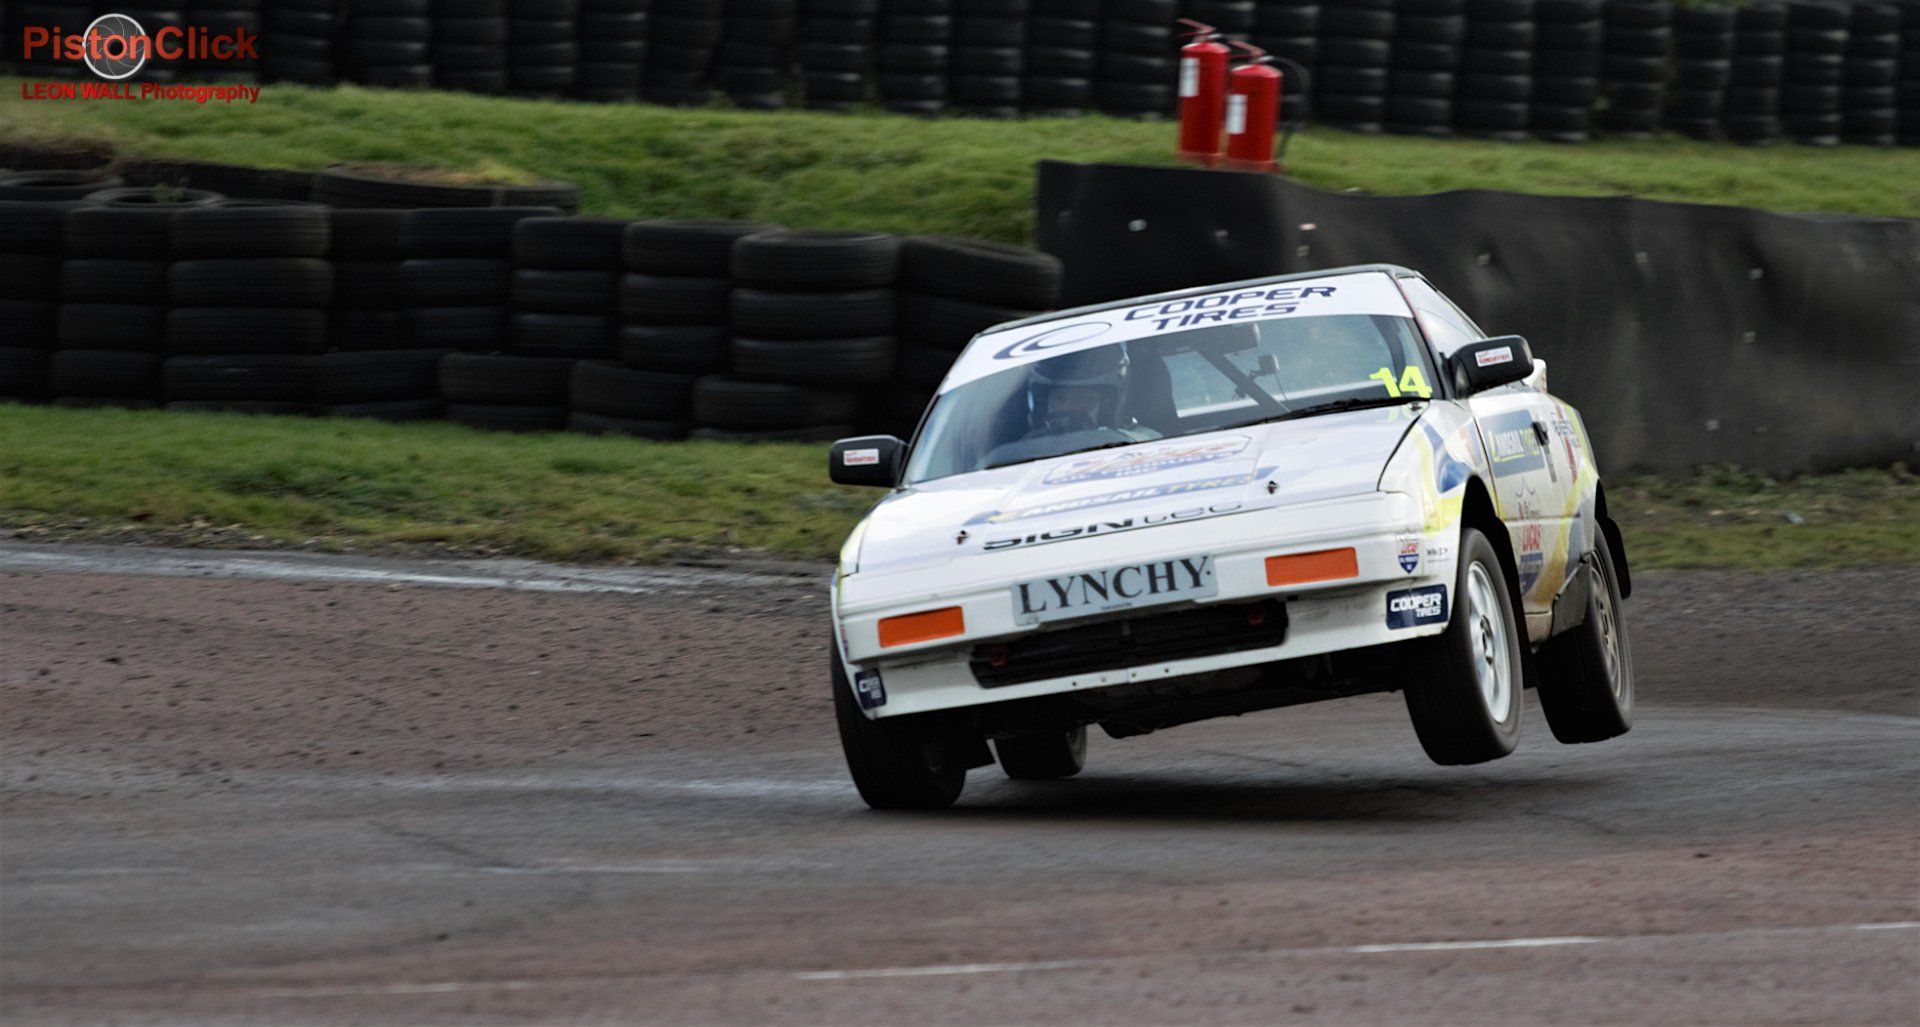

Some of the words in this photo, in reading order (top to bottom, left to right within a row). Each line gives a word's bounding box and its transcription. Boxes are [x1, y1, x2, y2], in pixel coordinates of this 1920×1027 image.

[1124, 286, 1337, 321] COOPER
[1152, 301, 1300, 331] TIRES
[1369, 365, 1433, 398] 14
[1018, 556, 1209, 614] LYNCHY
[1390, 593, 1442, 612] COOPER
